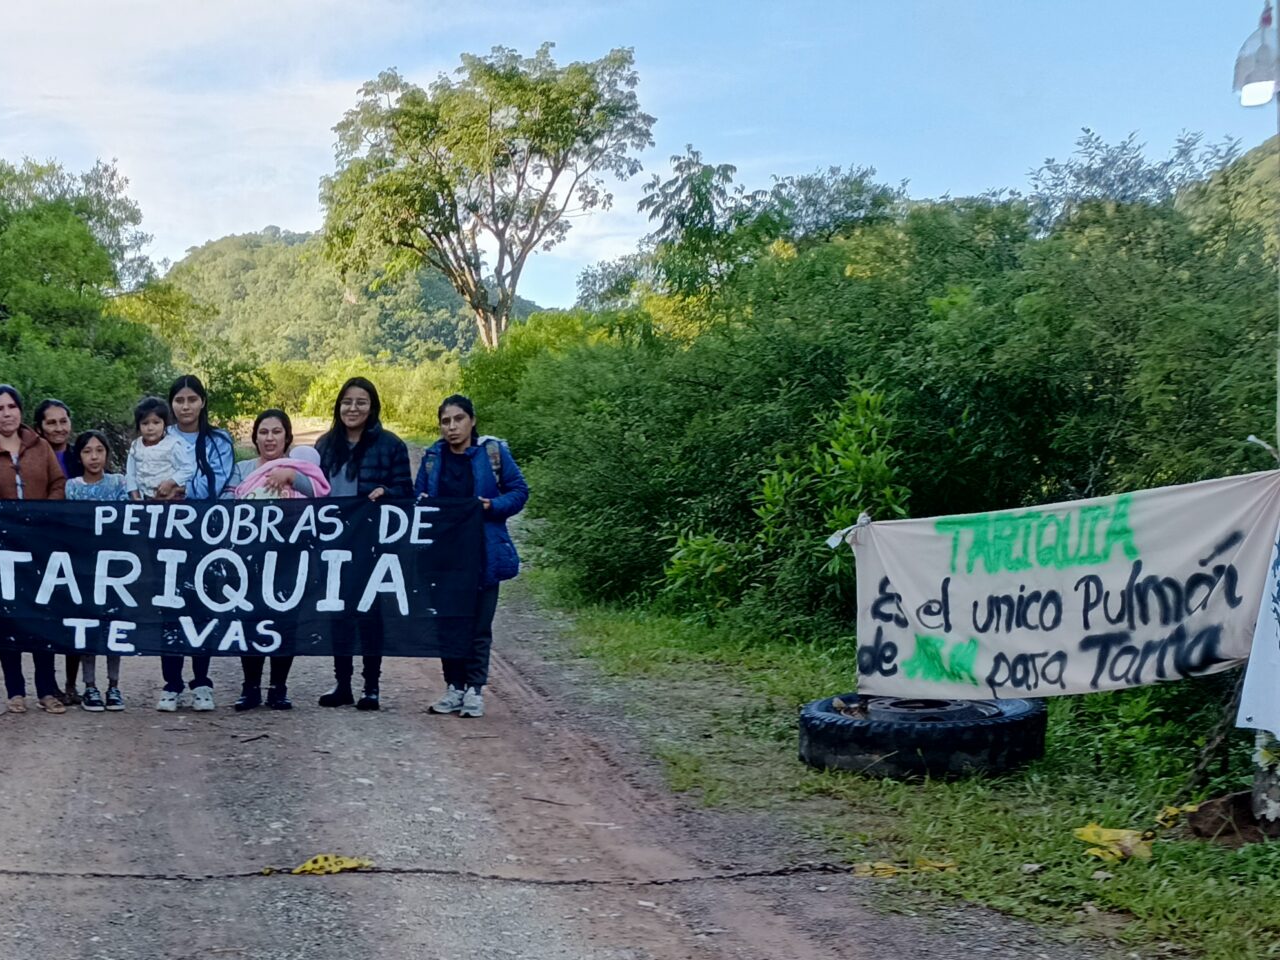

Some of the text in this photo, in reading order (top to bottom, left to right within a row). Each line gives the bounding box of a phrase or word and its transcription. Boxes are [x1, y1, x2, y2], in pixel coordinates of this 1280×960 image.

[95, 504, 440, 544] PETROBRAS DE
[916, 577, 952, 633] el
[972, 584, 1063, 633] unico
[63, 615, 283, 653] TE VAS
[857, 625, 898, 677] de
[985, 649, 1069, 699] para
